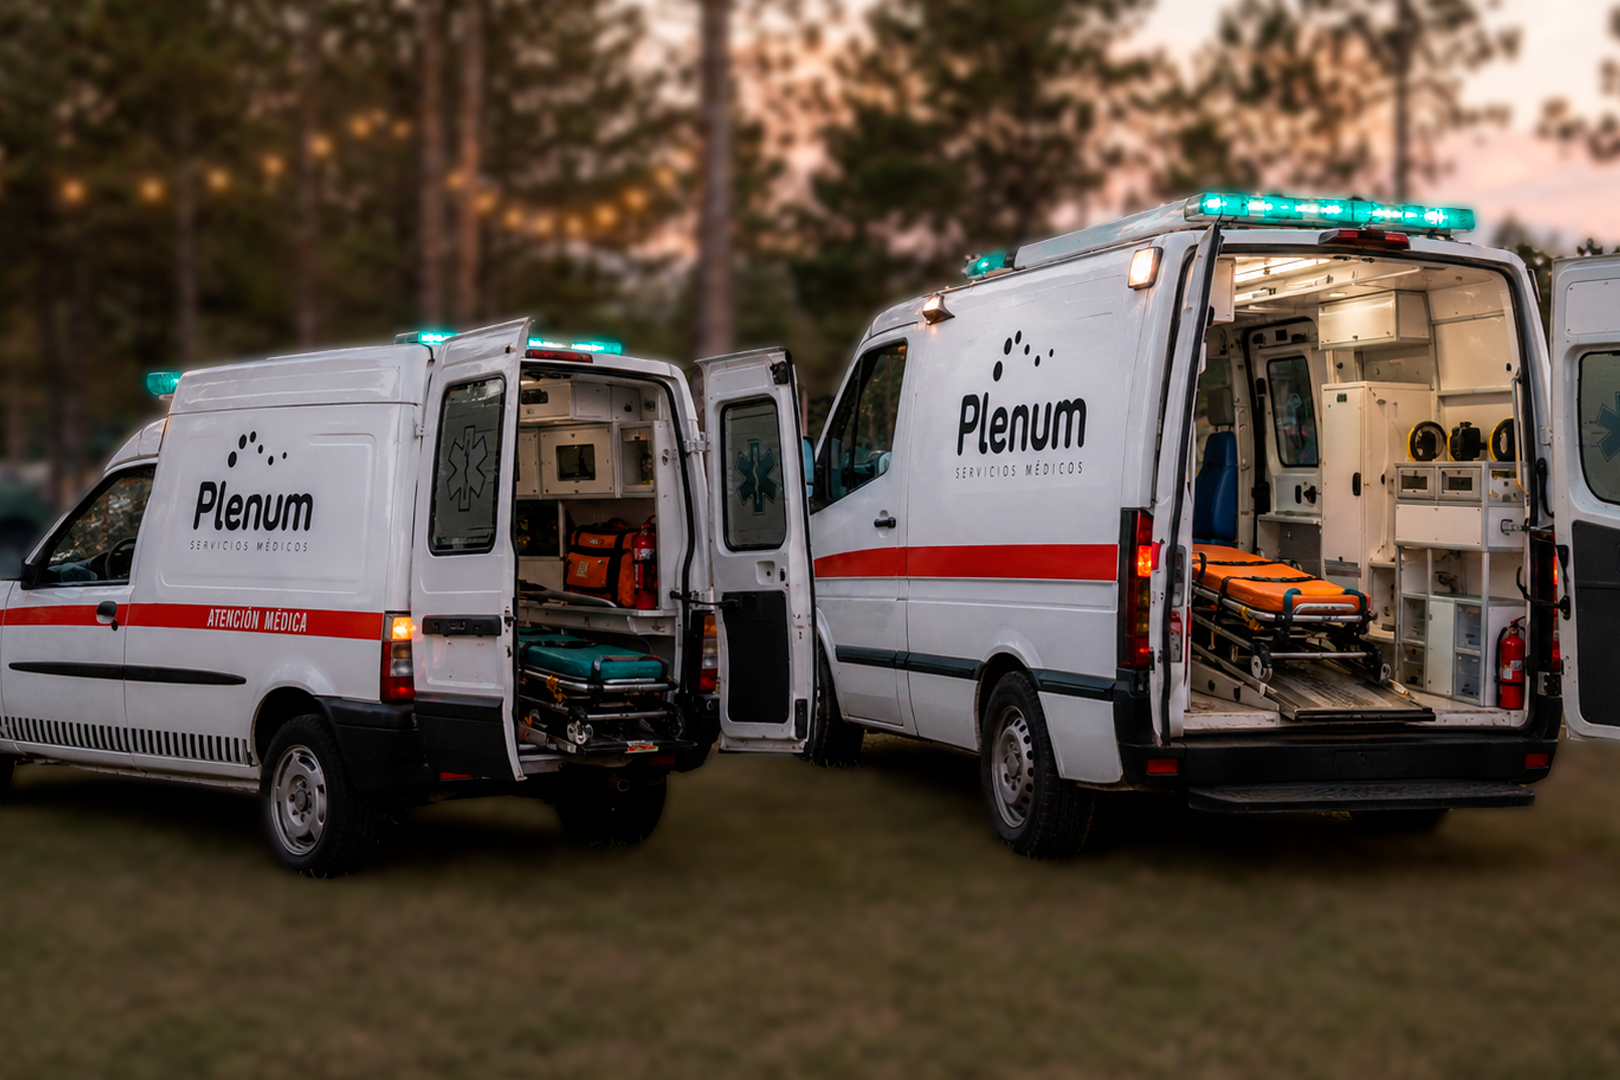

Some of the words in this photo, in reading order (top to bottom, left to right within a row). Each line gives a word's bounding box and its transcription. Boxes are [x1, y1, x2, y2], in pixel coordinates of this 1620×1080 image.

[957, 391, 1087, 456] Plenum
[955, 464, 1016, 479] SERVICIOS
[1025, 460, 1083, 476] MÉDICOS
[193, 480, 313, 531] Plenum
[190, 540, 249, 551] SERVICIOS
[256, 537, 308, 552] MÉDICOS
[207, 606, 260, 630] ATENCIÓN
[264, 608, 308, 633] MÉDICA
